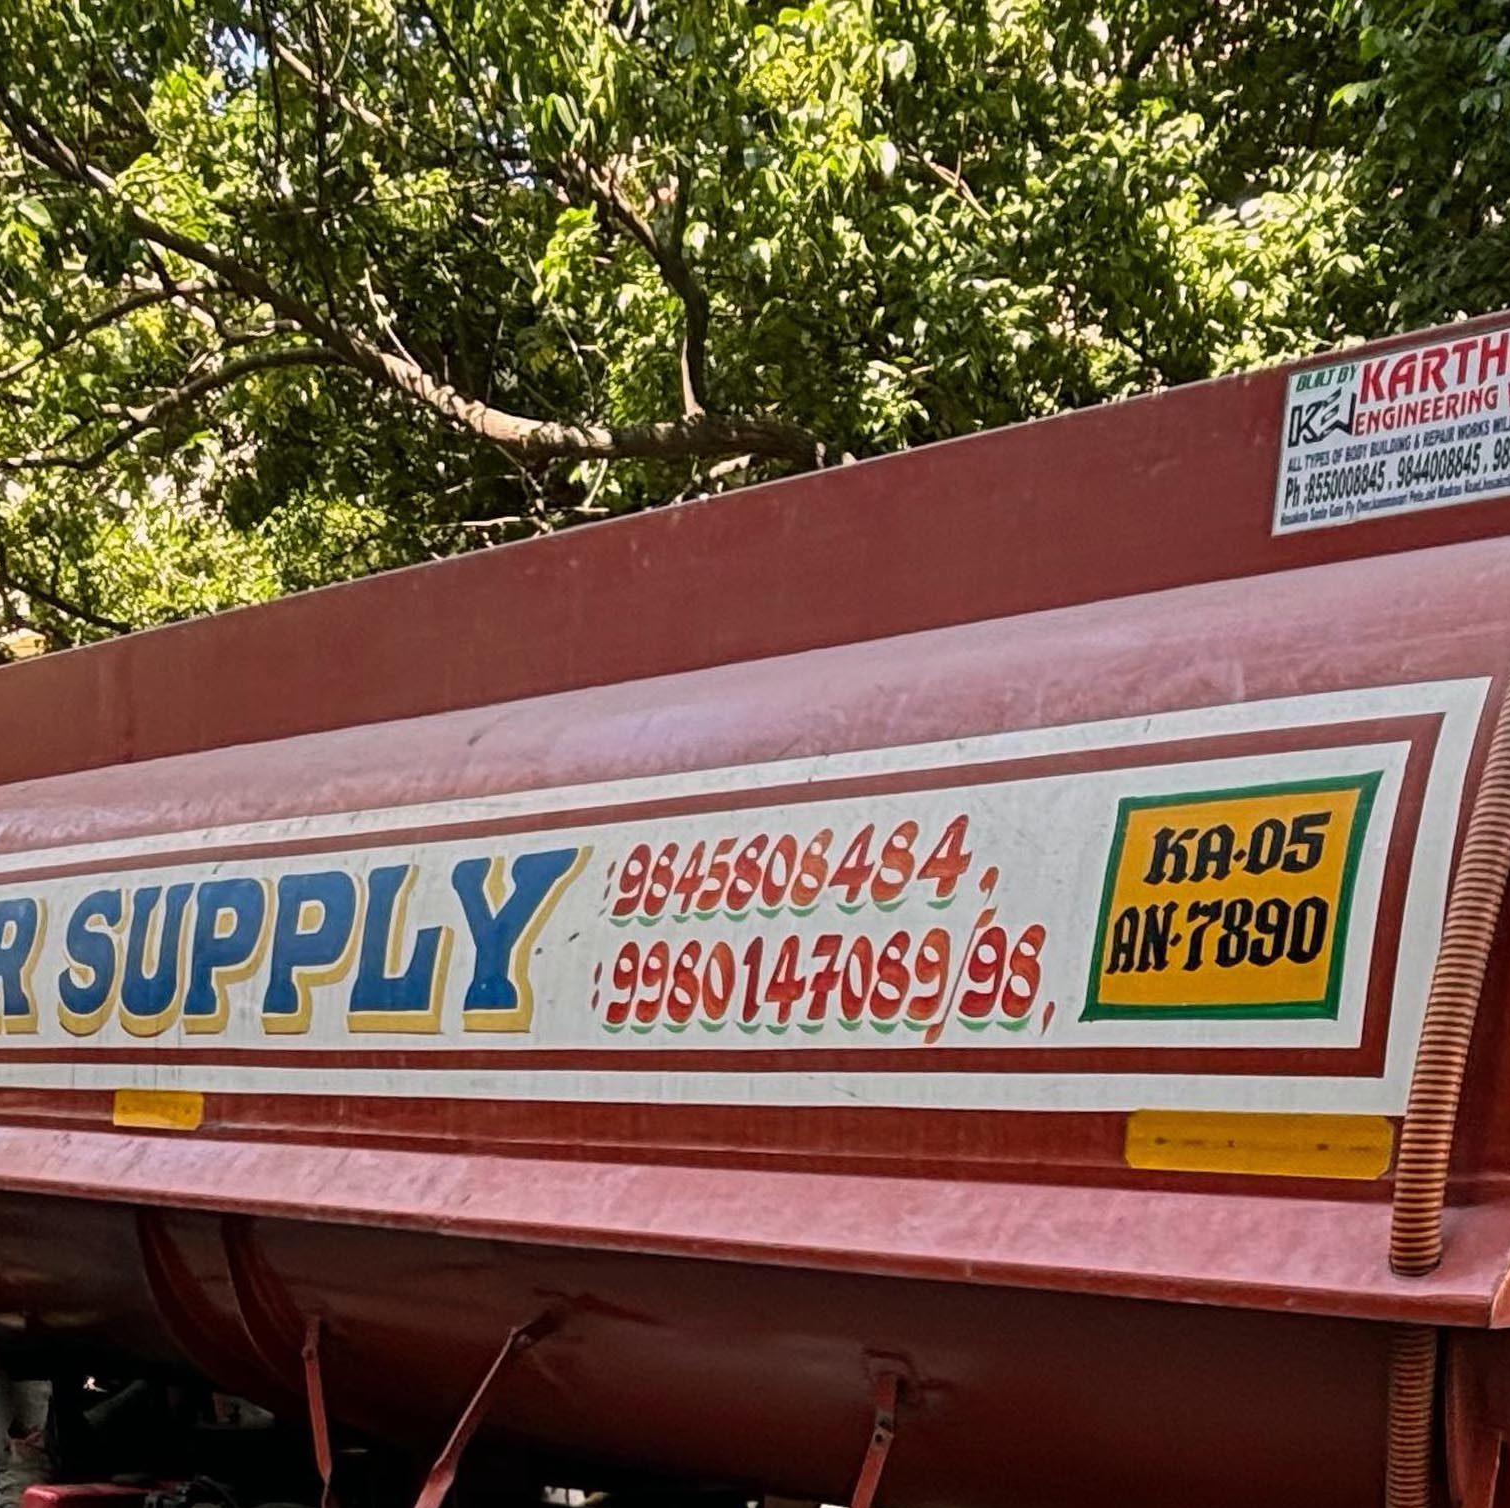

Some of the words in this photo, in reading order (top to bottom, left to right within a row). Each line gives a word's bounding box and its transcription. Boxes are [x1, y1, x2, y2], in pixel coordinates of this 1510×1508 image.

[1354, 384, 1499, 437] ENGINEERING
[1305, 450, 1330, 470] TYPES
[1370, 434, 1412, 456] BUILDING
[1423, 425, 1456, 446] REPAIR
[1457, 419, 1490, 439] WORKS
[1284, 477, 1300, 509] Ph
[57, 846, 595, 1036] SUPPLY
